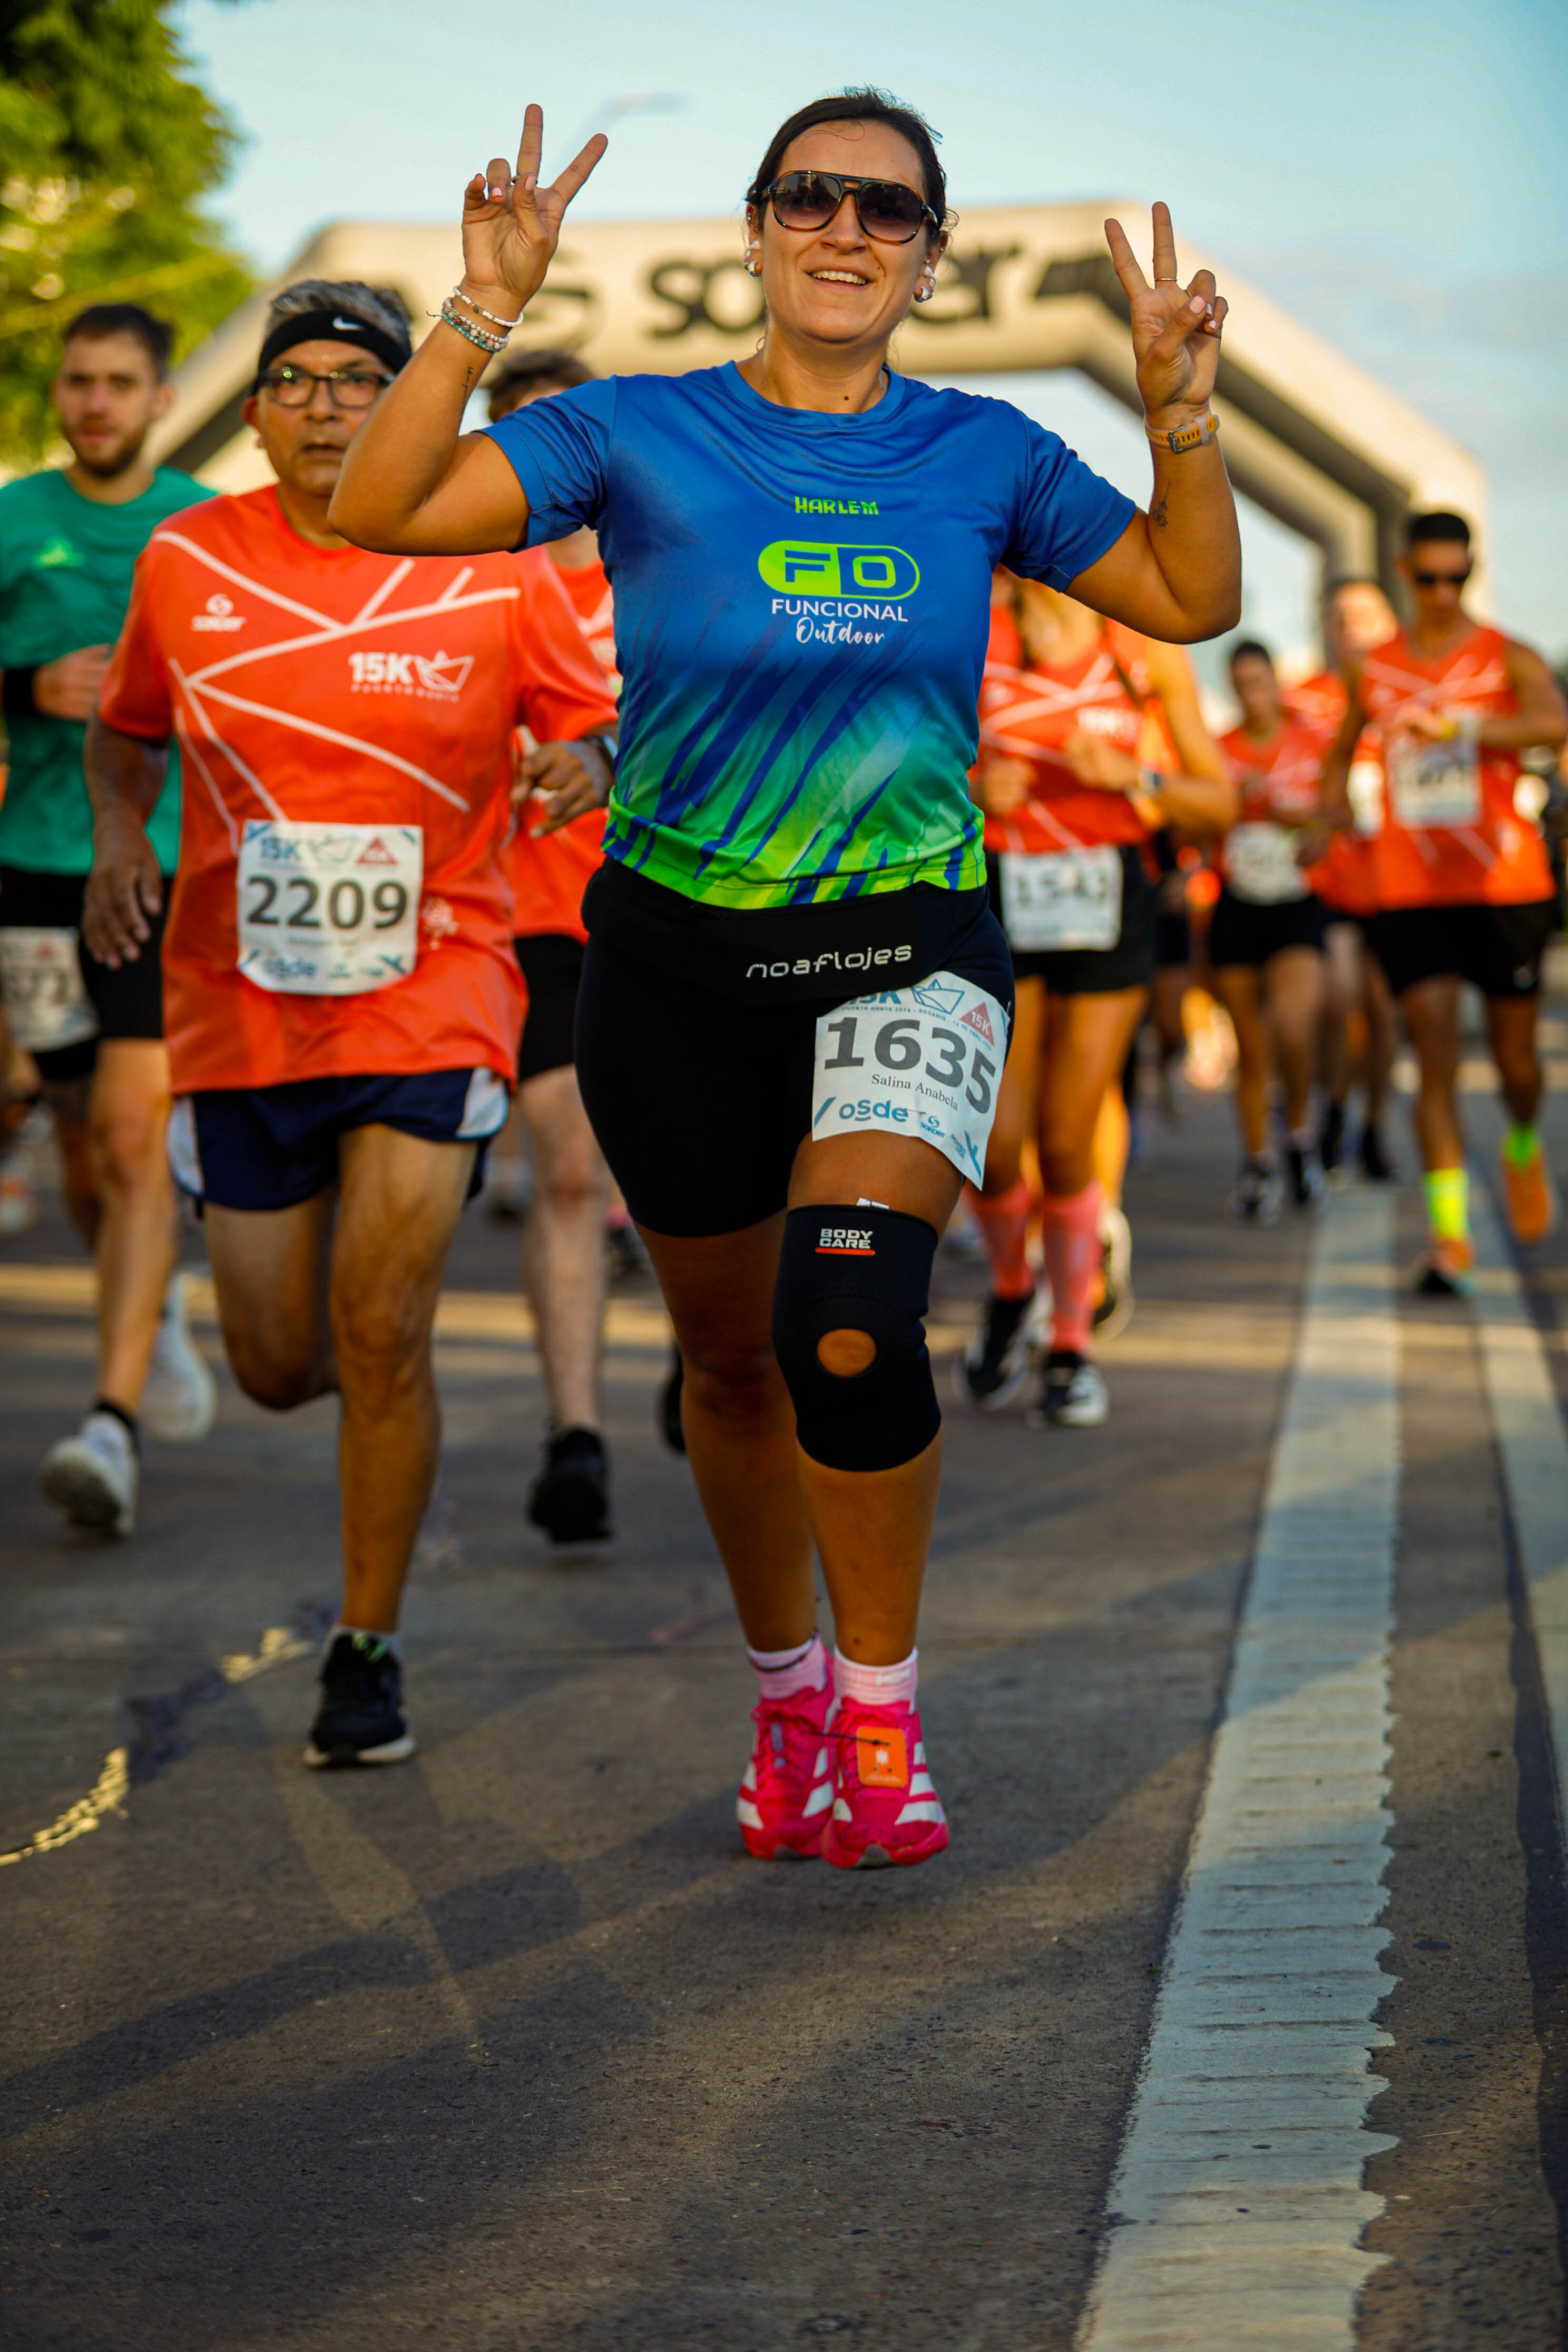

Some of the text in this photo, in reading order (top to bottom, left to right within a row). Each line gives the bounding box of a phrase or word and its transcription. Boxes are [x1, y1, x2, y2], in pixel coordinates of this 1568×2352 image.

[795, 495, 879, 515] HARLEM
[771, 599, 908, 622] FUNCIONAL
[796, 616, 885, 644] Outdoor
[348, 651, 415, 685] 15K
[246, 875, 408, 929] 2209
[746, 945, 912, 978] noaflojes
[919, 1008, 946, 1021] ROSARIO
[971, 1011, 991, 1036] 15K
[824, 1016, 996, 1114] 1635
[871, 1073, 958, 1111] Salina Anabela
[839, 1099, 909, 1122] osde
[819, 1238, 870, 1249] CARE
[820, 1228, 873, 1239] BODY
